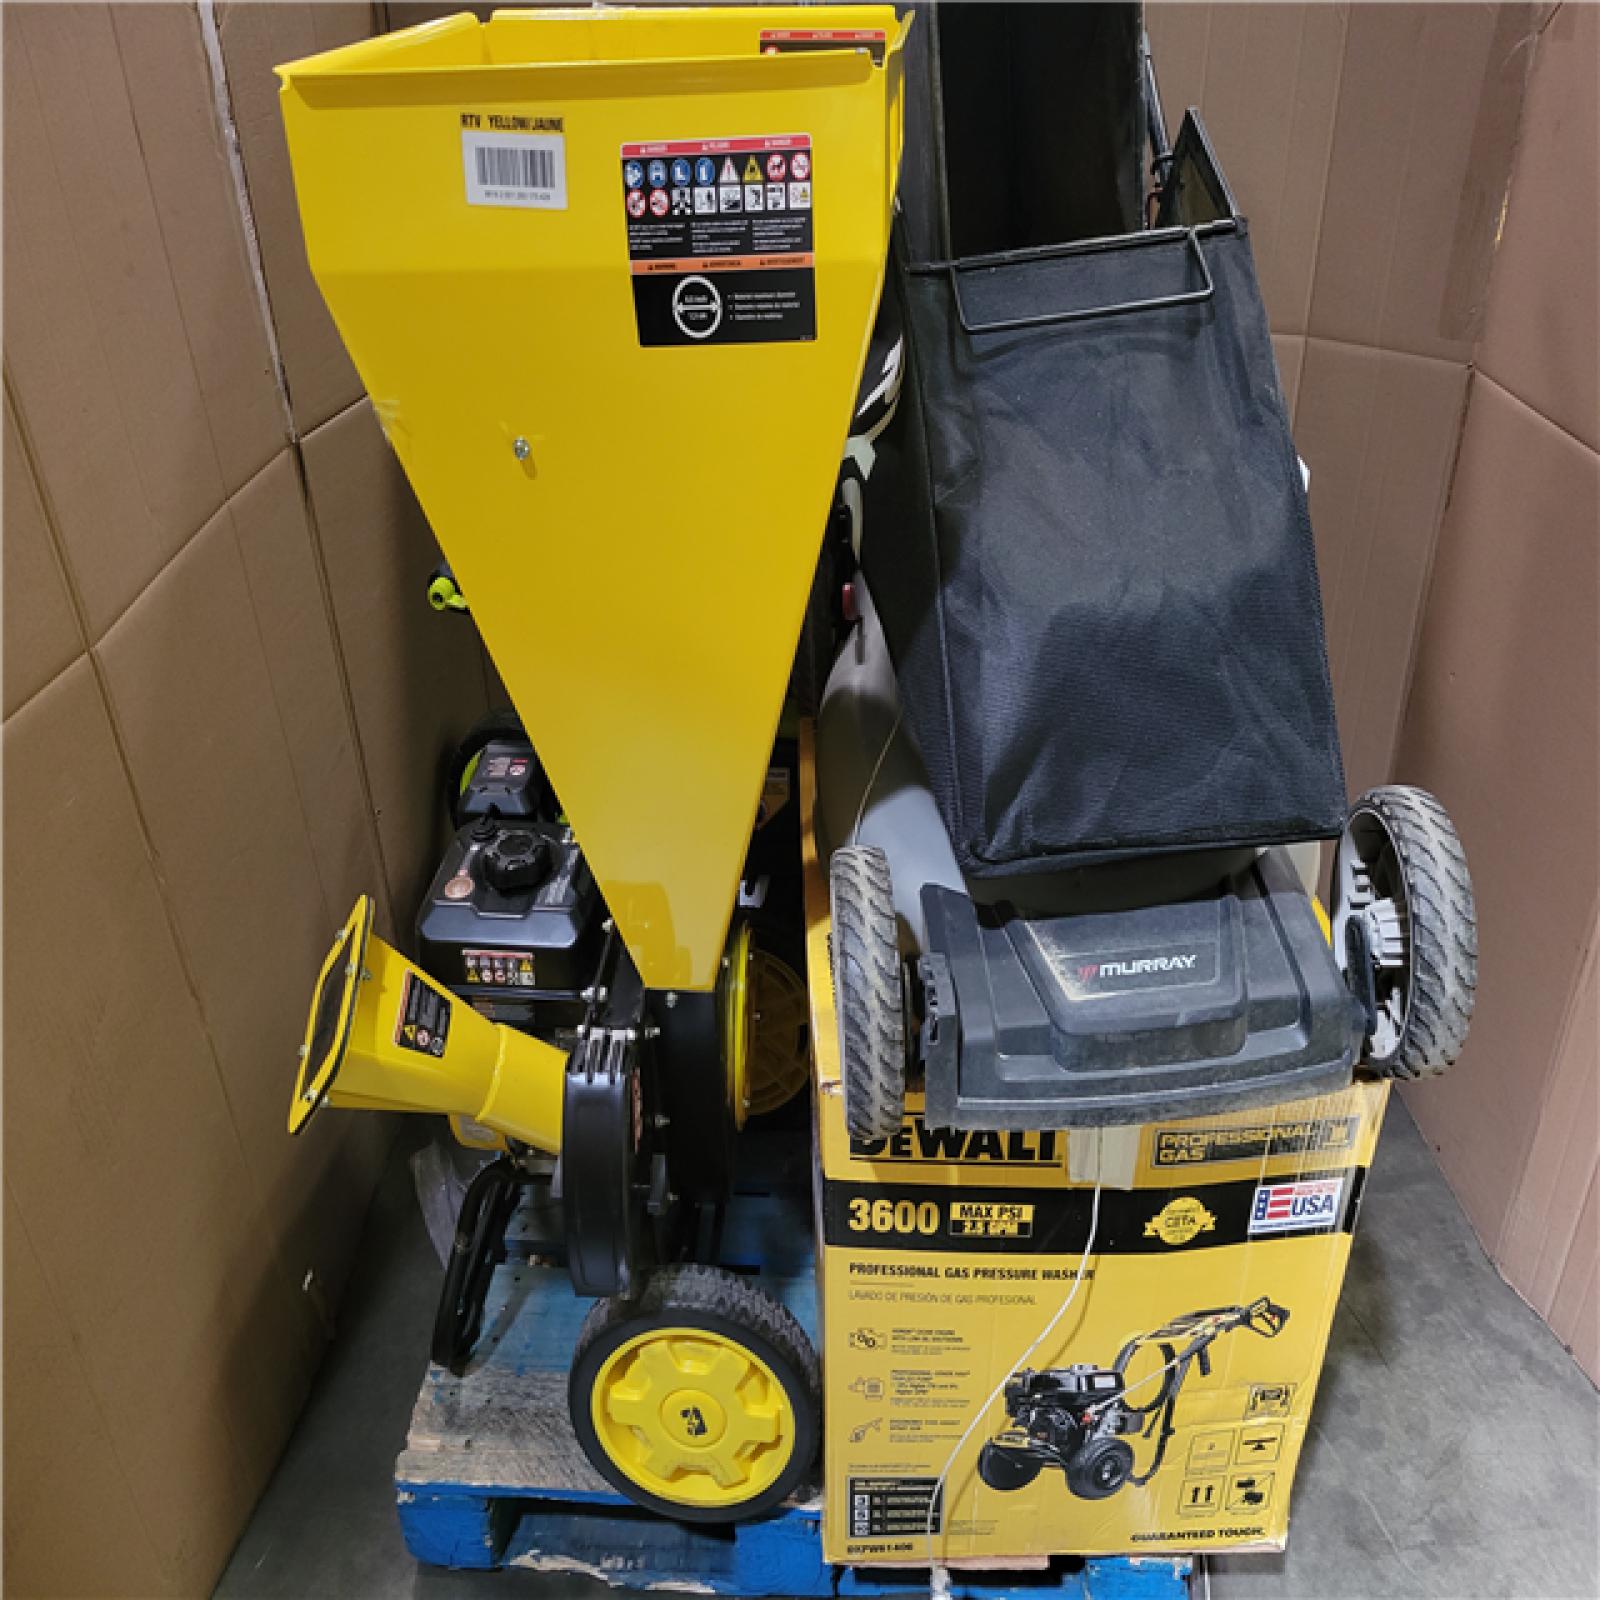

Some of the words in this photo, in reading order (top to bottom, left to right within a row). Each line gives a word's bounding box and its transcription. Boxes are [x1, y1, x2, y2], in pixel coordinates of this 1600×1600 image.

[461, 113, 481, 129] RTV
[1100, 954, 1197, 977] MURRAY
[1159, 1123, 1314, 1146] PROFESSIONAL
[1158, 1147, 1206, 1164] GAS
[959, 1204, 993, 1219] MAX
[998, 1206, 1024, 1221] PSI
[1291, 1194, 1335, 1217] USA
[849, 1198, 941, 1236] 3600
[849, 1262, 940, 1278] PROFESSIONAL
[944, 1267, 970, 1279] GAS
[973, 1267, 1038, 1280] PRESSURE
[885, 1292, 898, 1303] DE
[1130, 1529, 1216, 1543] GUARANTEED
